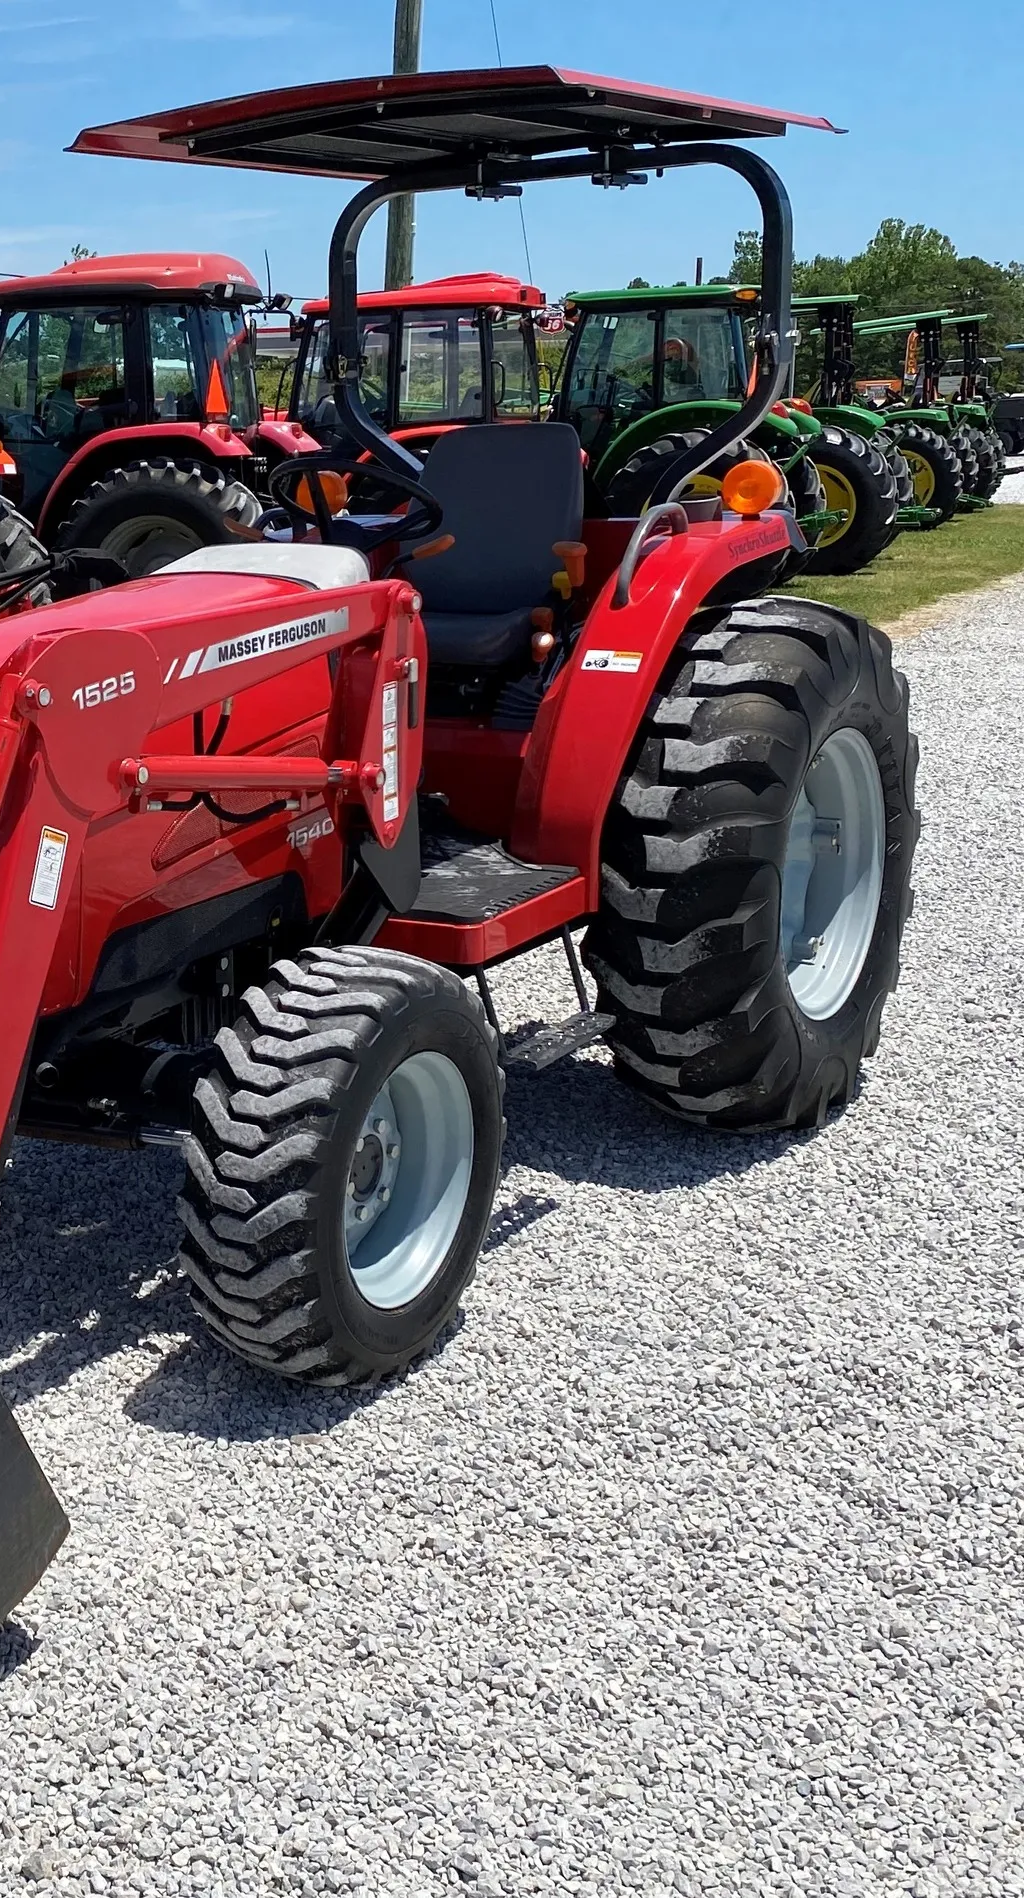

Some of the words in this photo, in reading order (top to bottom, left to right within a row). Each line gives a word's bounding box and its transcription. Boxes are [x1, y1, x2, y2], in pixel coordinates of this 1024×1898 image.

[217, 634, 267, 663] MASSEY
[267, 617, 326, 649] FERGUSON
[71, 670, 136, 711] 1525
[286, 816, 335, 850] 1540
